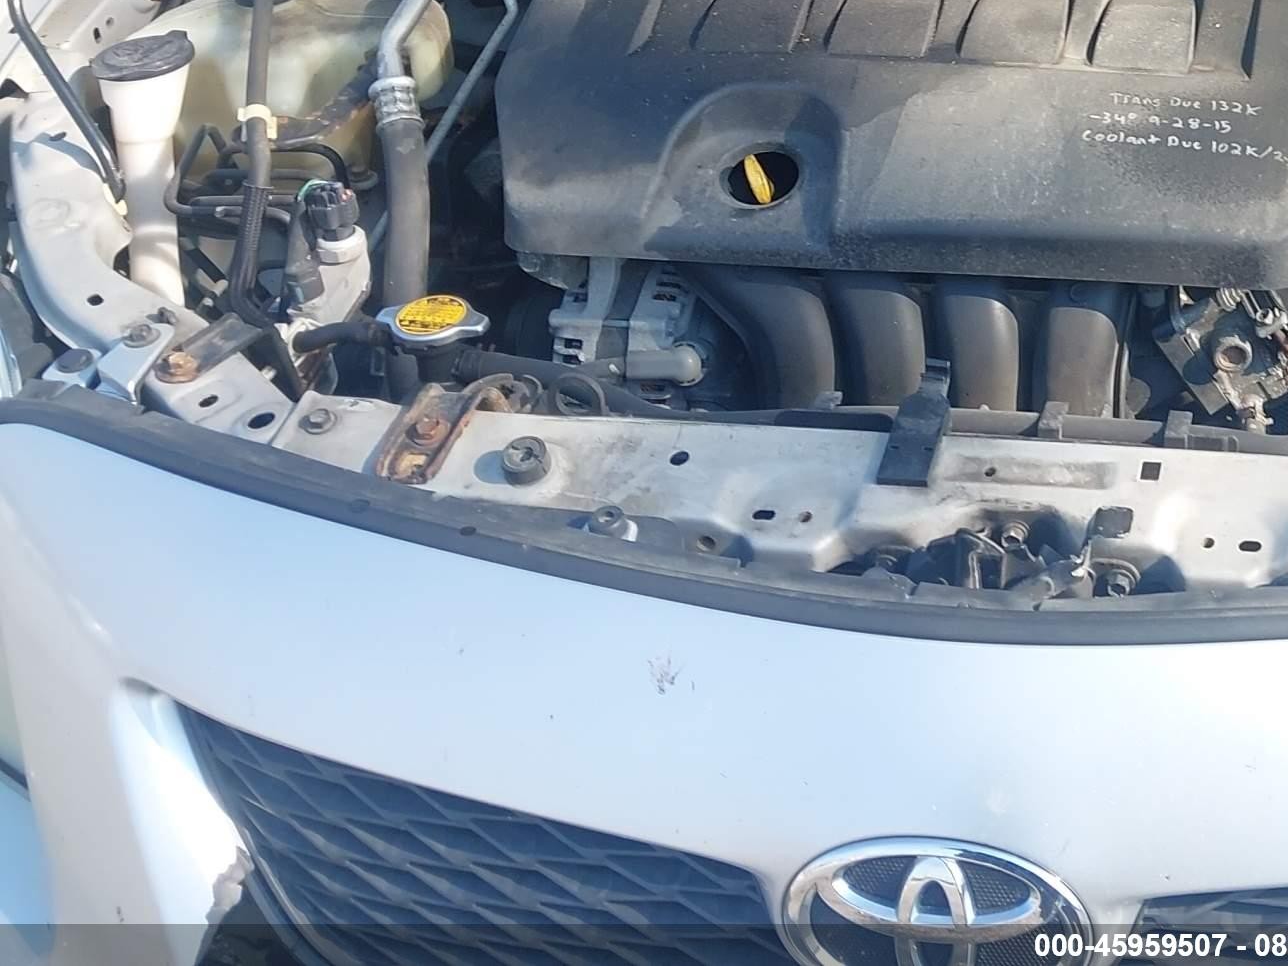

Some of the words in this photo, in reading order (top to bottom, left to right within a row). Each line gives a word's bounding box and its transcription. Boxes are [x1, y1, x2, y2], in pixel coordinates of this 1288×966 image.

[1109, 92, 1161, 107] Trans
[1170, 97, 1201, 109] Due
[1211, 100, 1262, 116] 132K
[1149, 115, 1232, 133] 9-28-15
[1082, 130, 1161, 145] Coolant
[1168, 135, 1202, 151] Due
